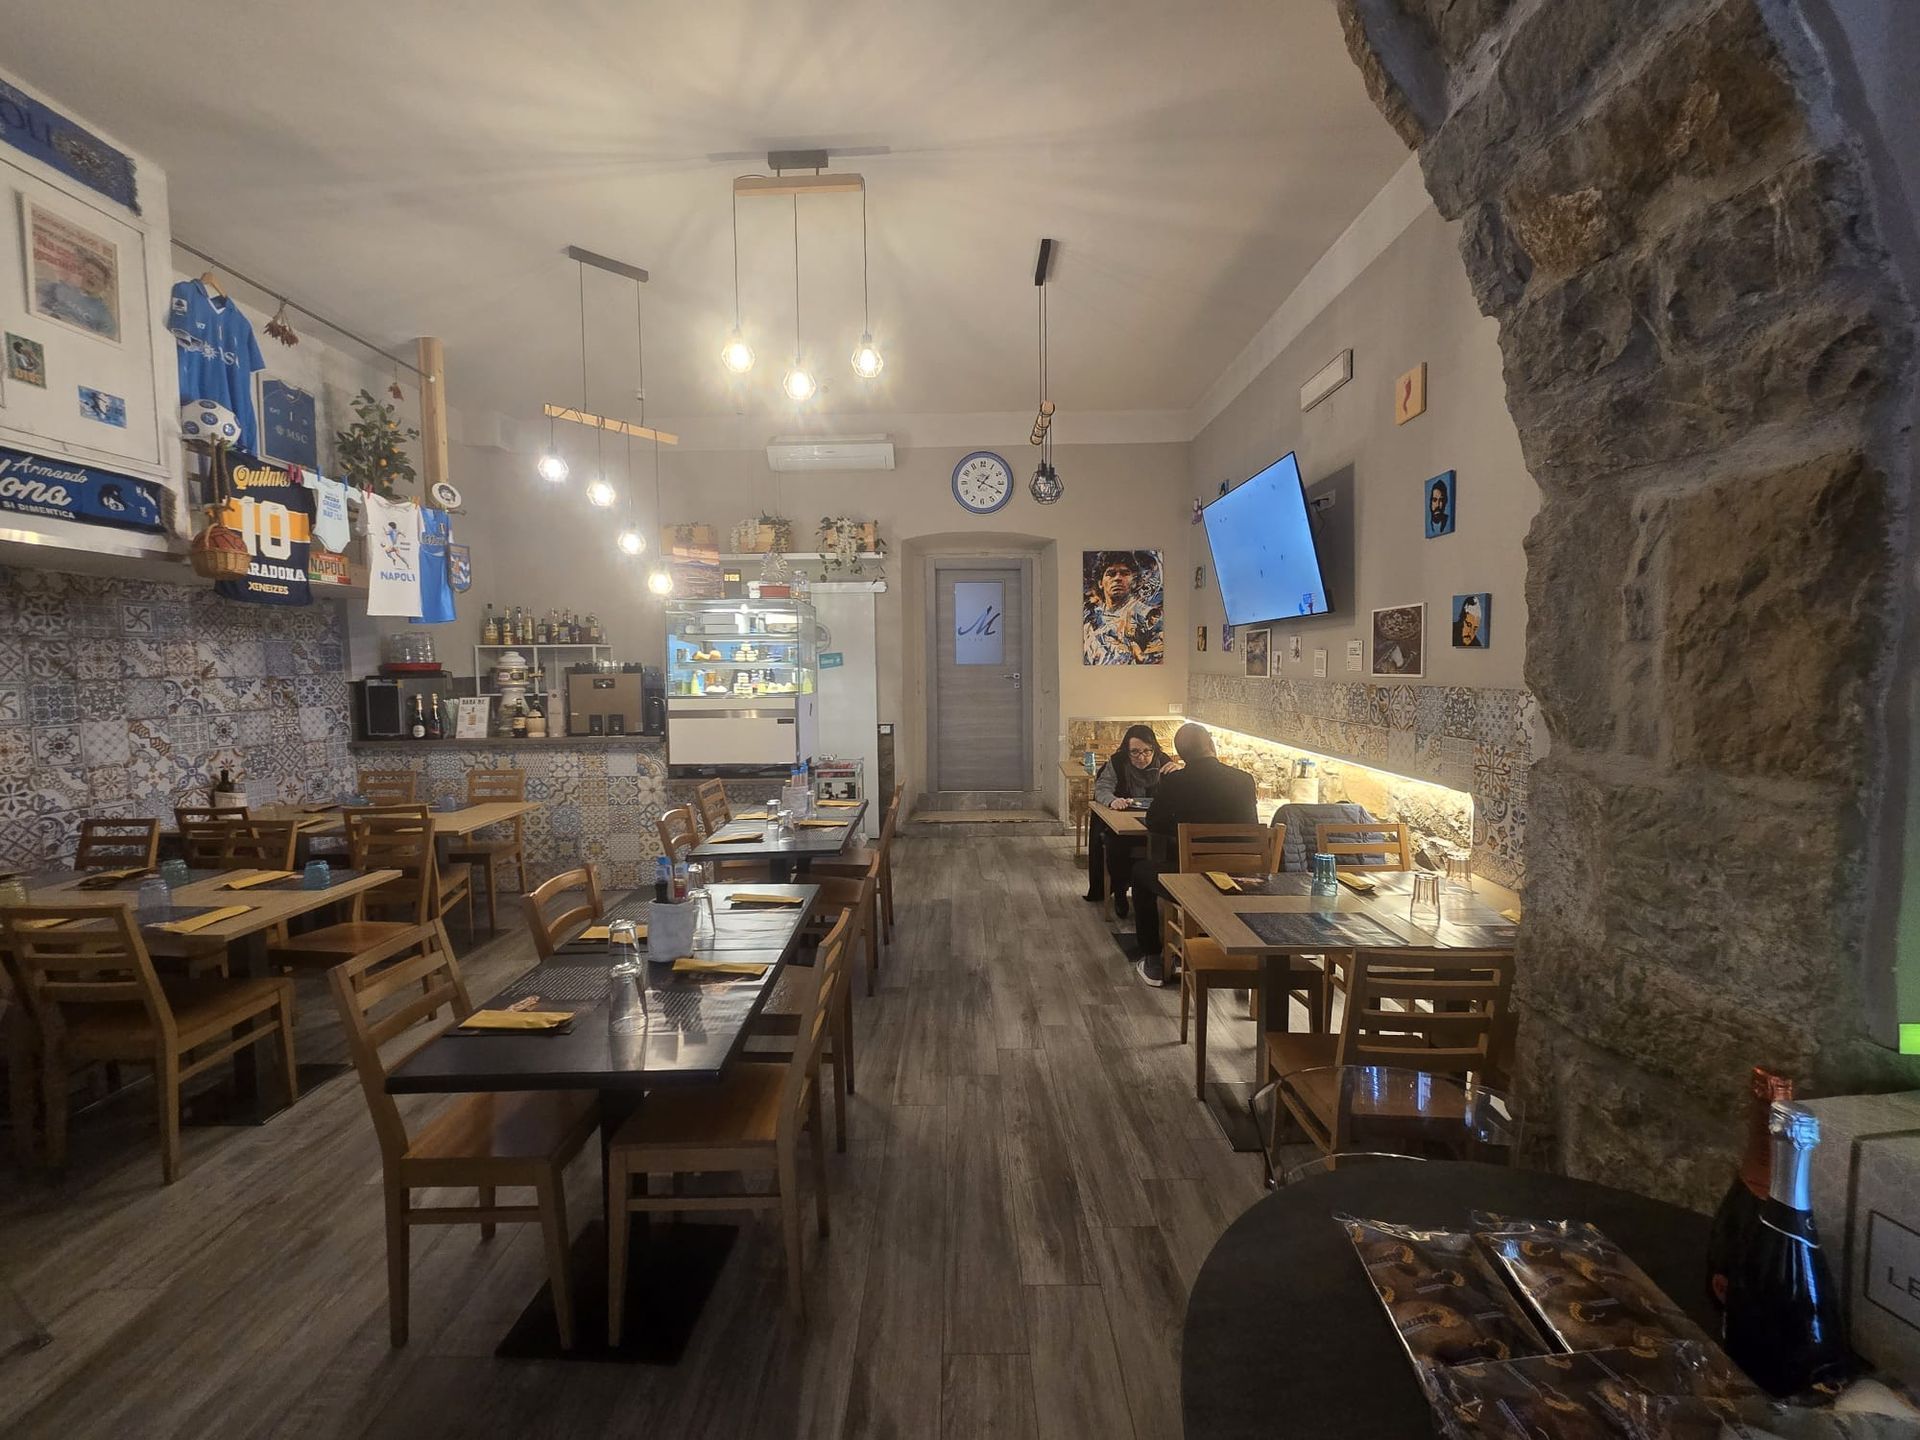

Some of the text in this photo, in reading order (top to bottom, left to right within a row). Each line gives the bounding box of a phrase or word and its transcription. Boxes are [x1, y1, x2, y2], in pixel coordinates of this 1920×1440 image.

[12, 456, 88, 483] Armando
[233, 464, 290, 490] Quilmes
[0, 459, 72, 506] ona
[19, 503, 76, 519] DIMENTICA
[241, 495, 291, 560] 10
[247, 562, 307, 582] RADONA
[310, 557, 346, 577] NAPOLI
[380, 571, 416, 582] NAPOLI
